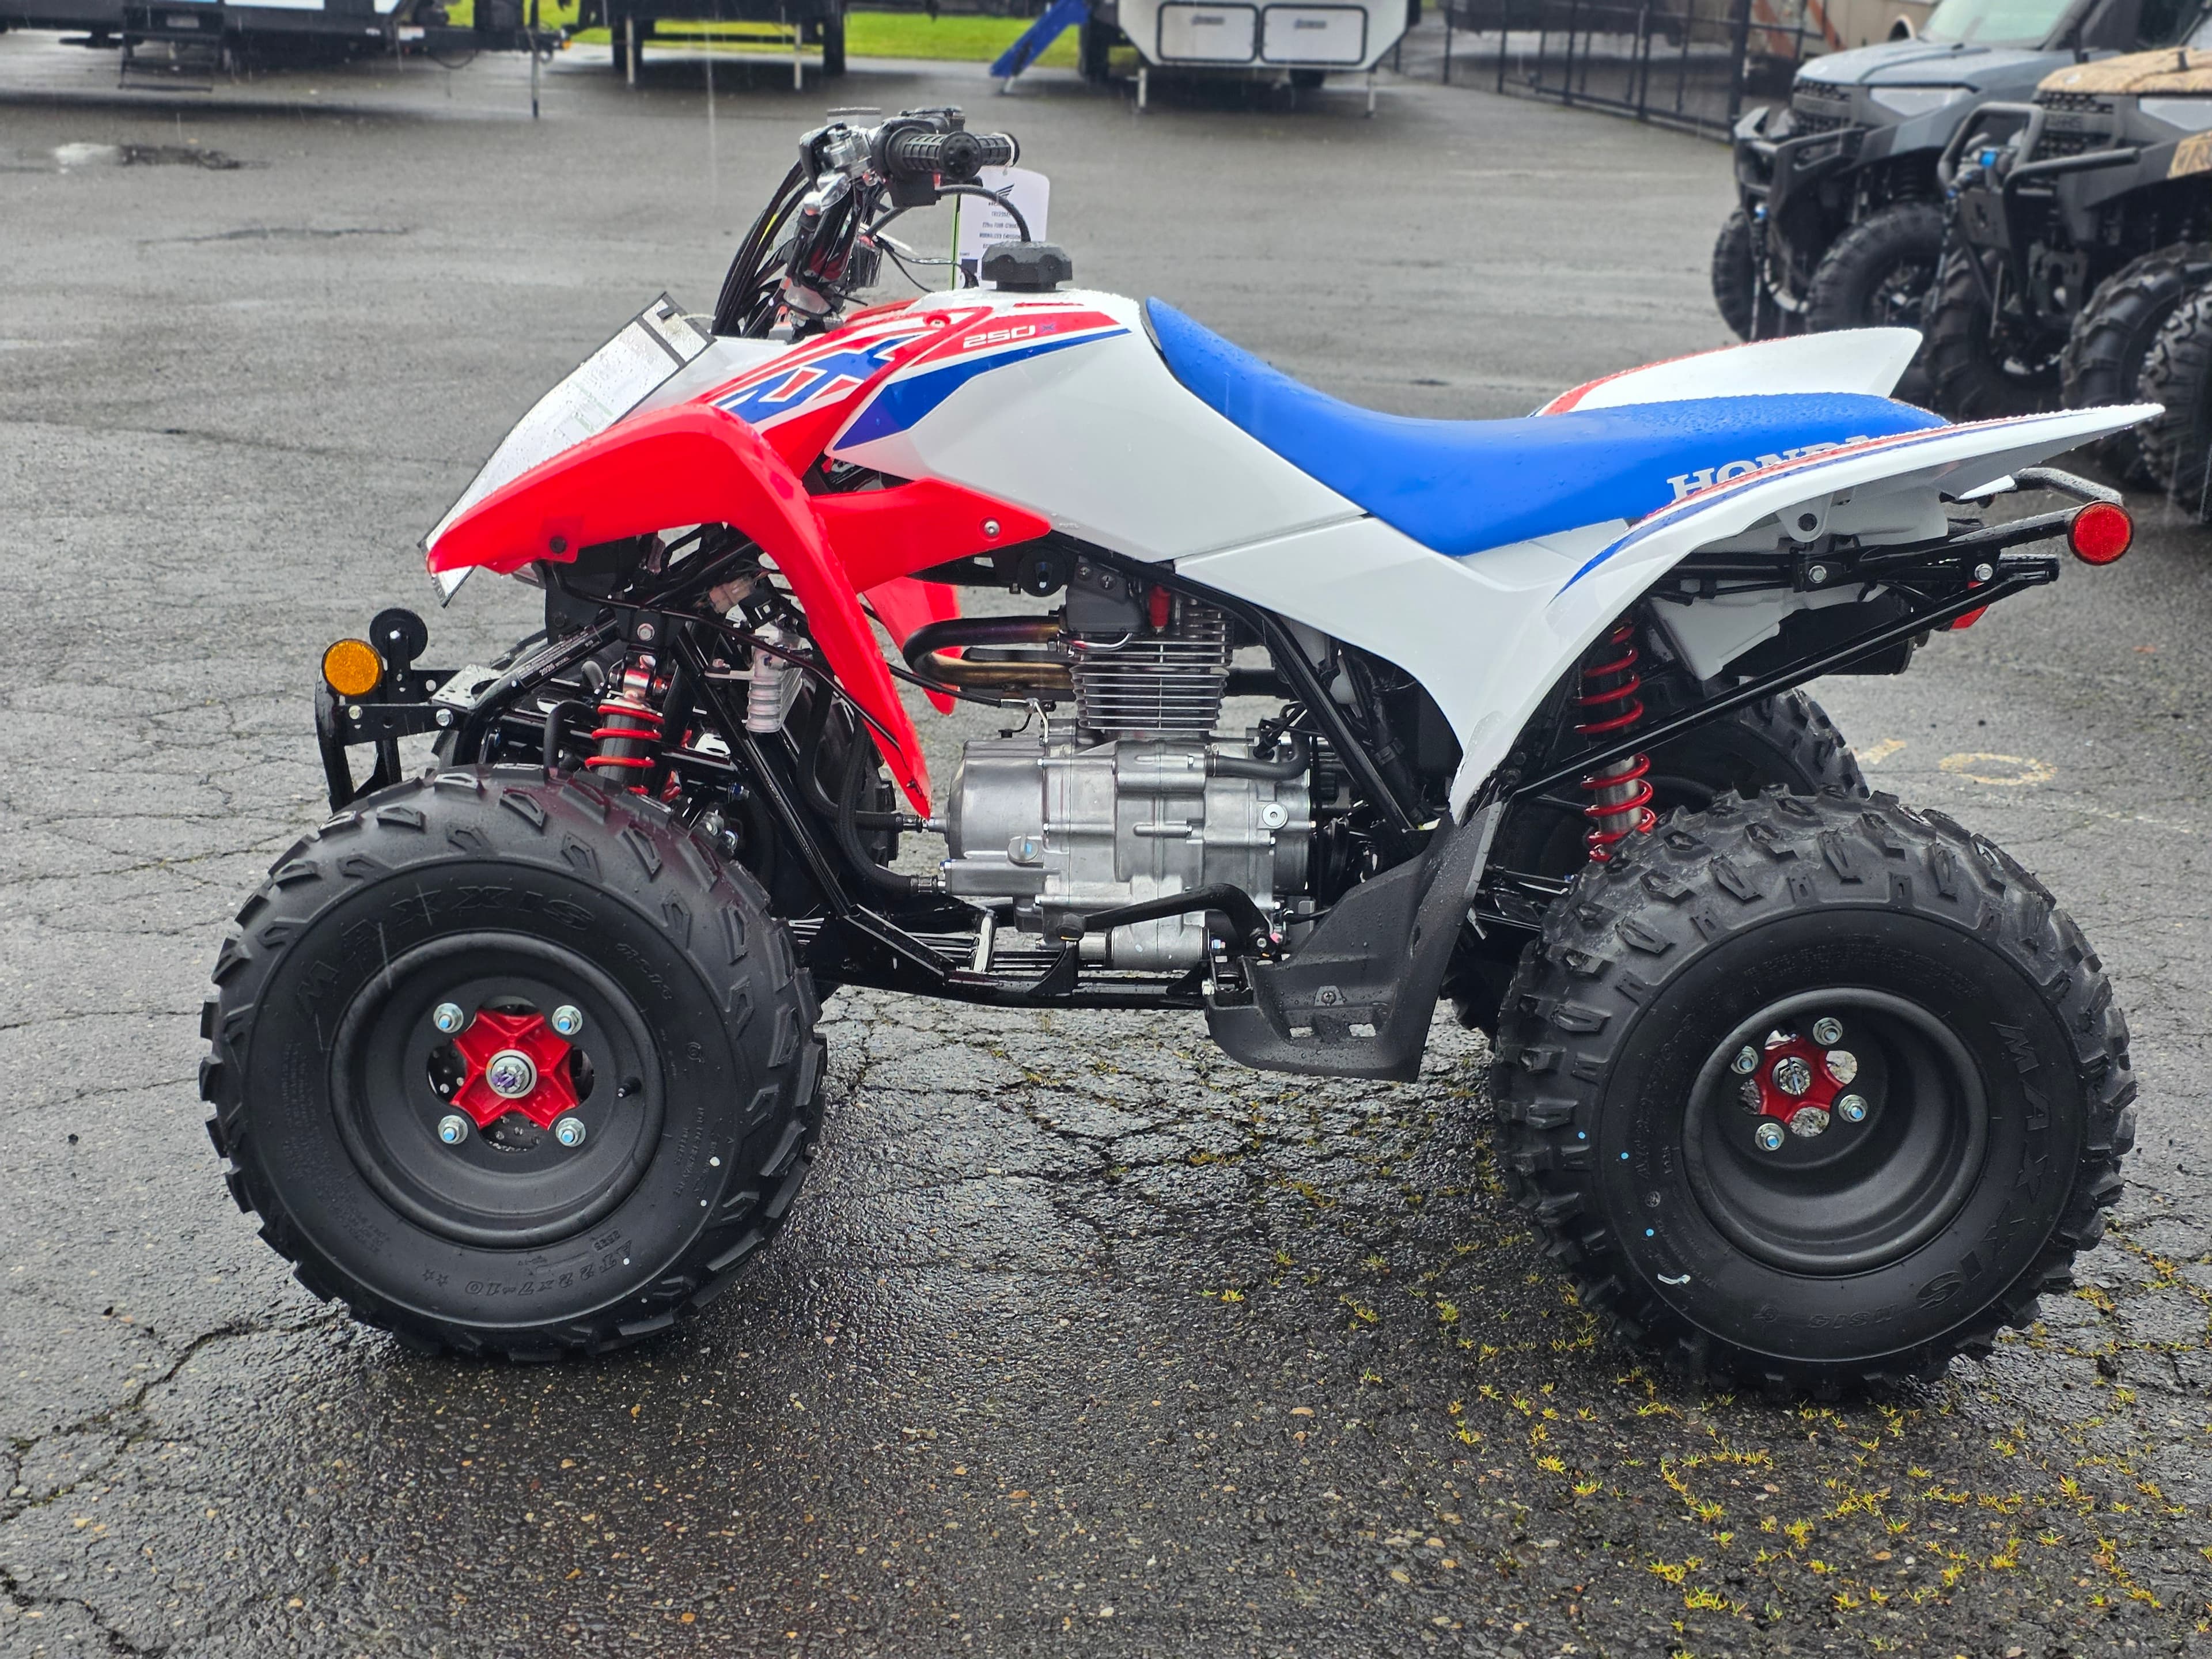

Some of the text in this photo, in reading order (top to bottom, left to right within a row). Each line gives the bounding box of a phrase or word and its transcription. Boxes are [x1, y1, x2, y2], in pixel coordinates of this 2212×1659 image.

[963, 325, 1036, 349] 250
[297, 885, 596, 1013] MAXXIS
[1915, 1021, 2052, 1310] MAXXIS
